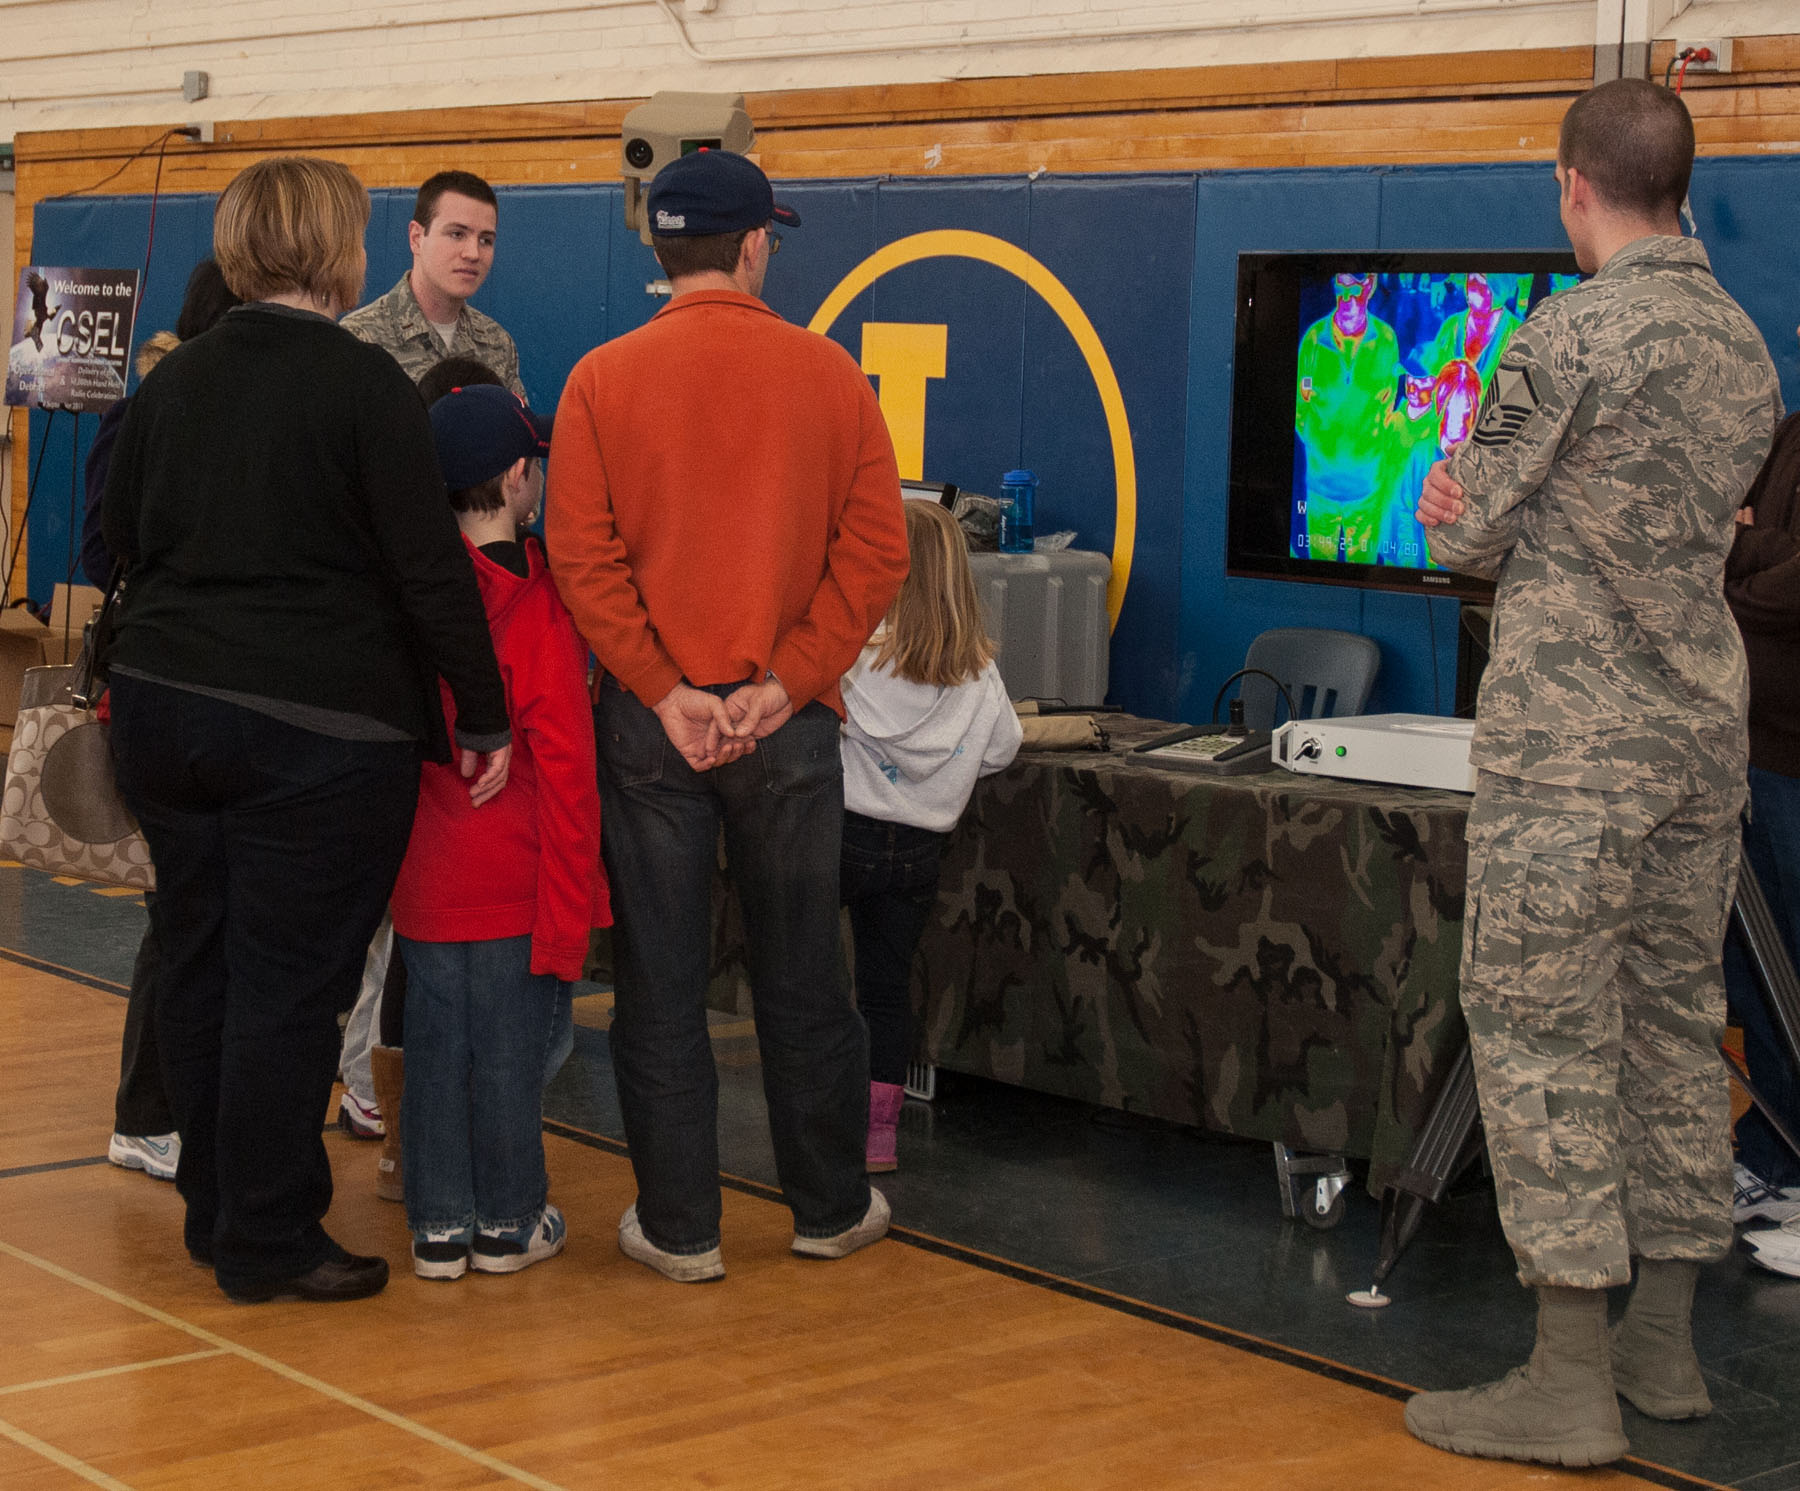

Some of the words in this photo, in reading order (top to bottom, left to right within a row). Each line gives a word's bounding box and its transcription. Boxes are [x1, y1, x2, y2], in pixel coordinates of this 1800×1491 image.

[53, 279, 100, 296] Welcome
[102, 283, 113, 296] to
[115, 282, 132, 297] the
[57, 310, 125, 356] CSEL
[1422, 575, 1451, 585] SAMSUNG
